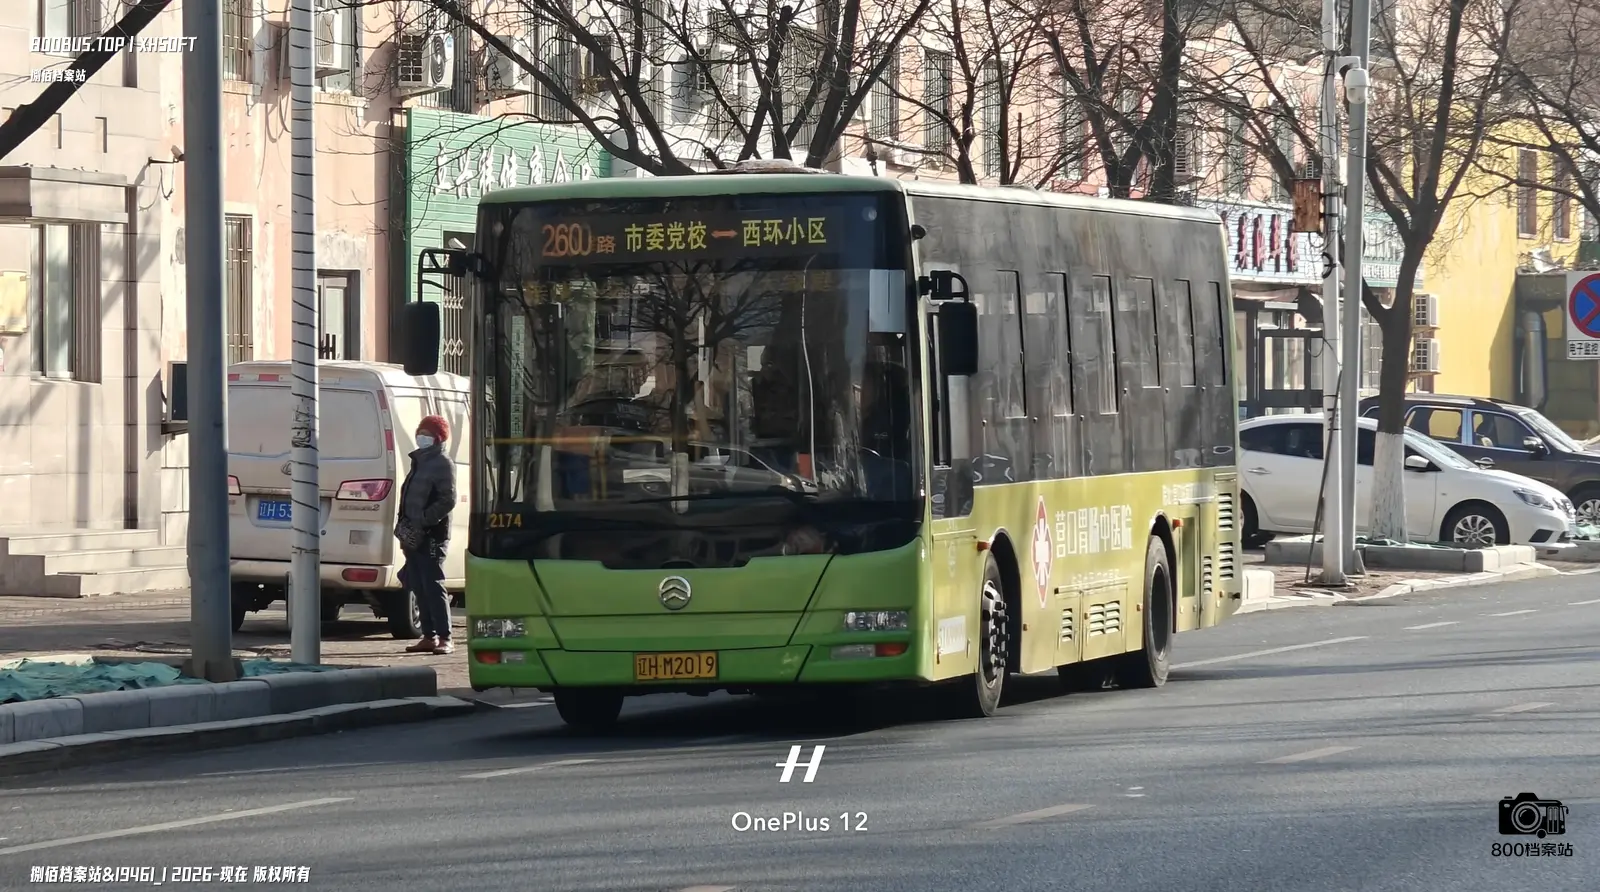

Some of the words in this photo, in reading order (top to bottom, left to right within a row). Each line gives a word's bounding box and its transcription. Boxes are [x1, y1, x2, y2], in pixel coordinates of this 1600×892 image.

[625, 221, 707, 253] 市委党校
[741, 217, 827, 247] 西环小区
[489, 512, 522, 528] 2174
